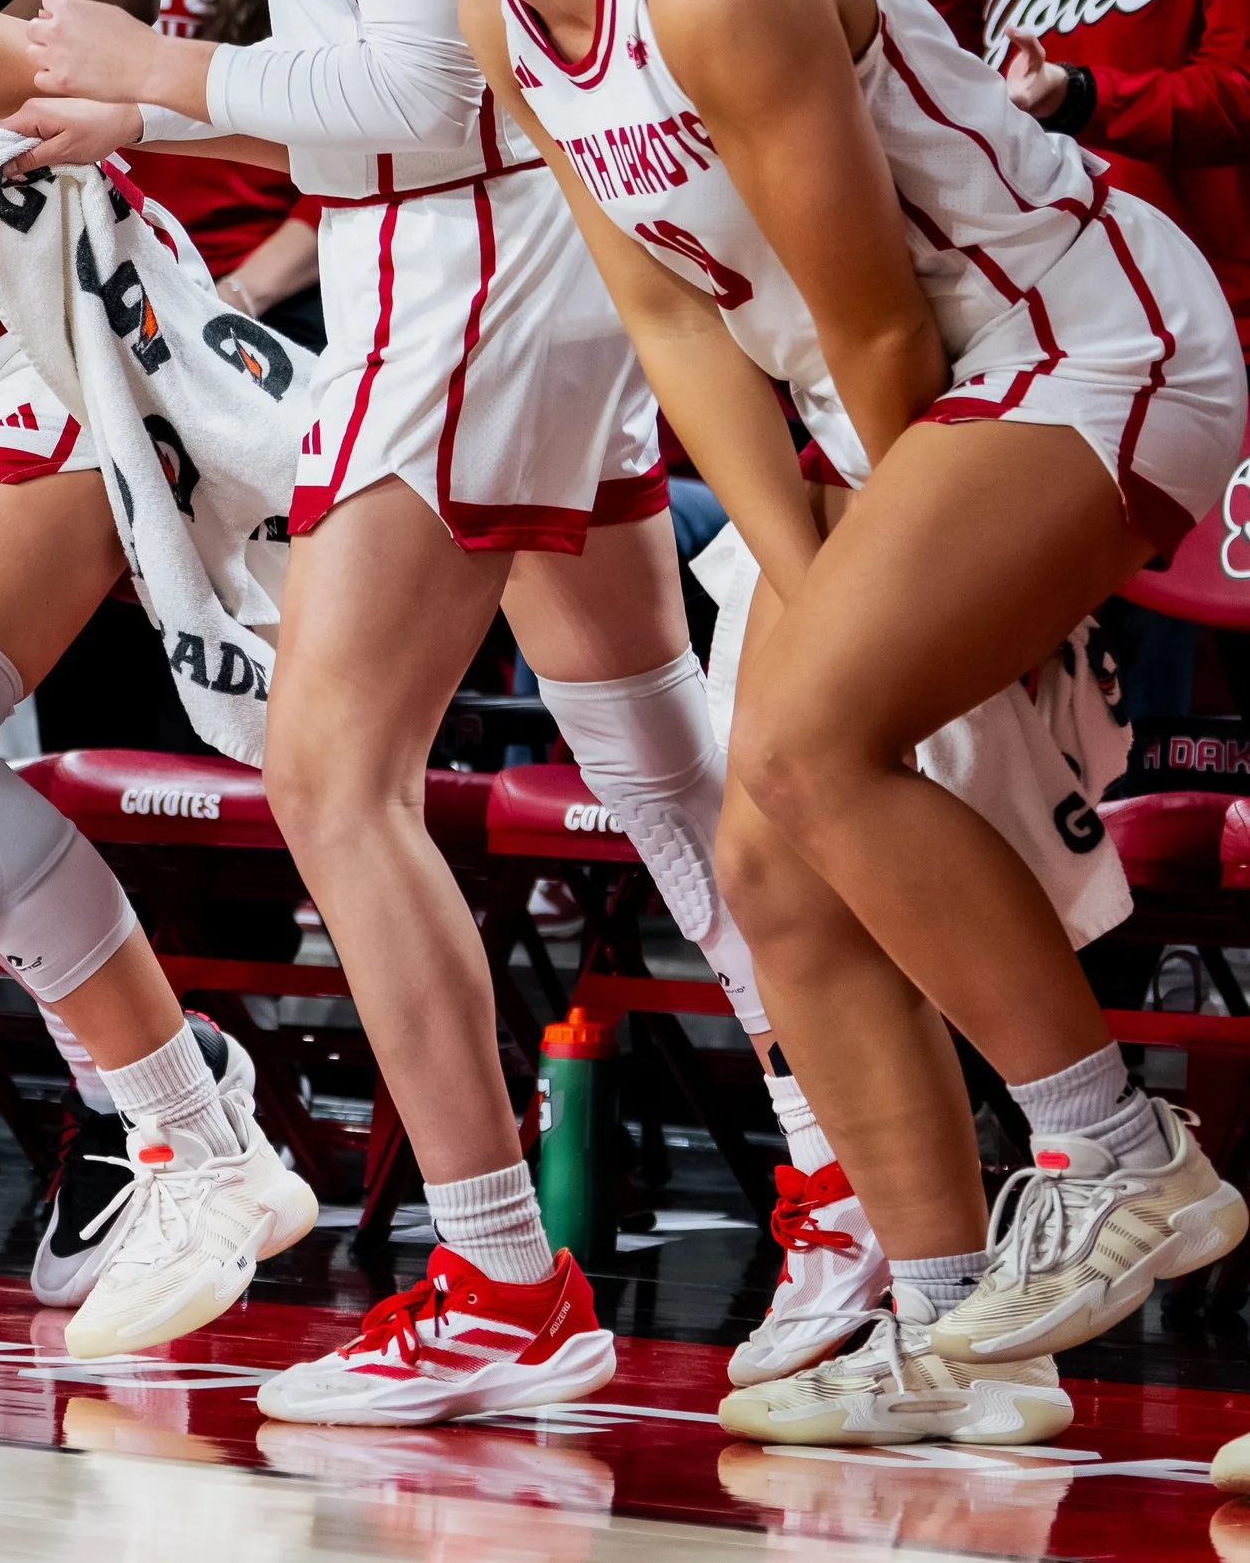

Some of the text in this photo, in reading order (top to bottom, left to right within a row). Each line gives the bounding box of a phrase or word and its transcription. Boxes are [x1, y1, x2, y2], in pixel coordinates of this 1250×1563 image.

[121, 788, 222, 820] COYOTES
[565, 804, 624, 834] COYO
[549, 1300, 571, 1338] ADIZERO
